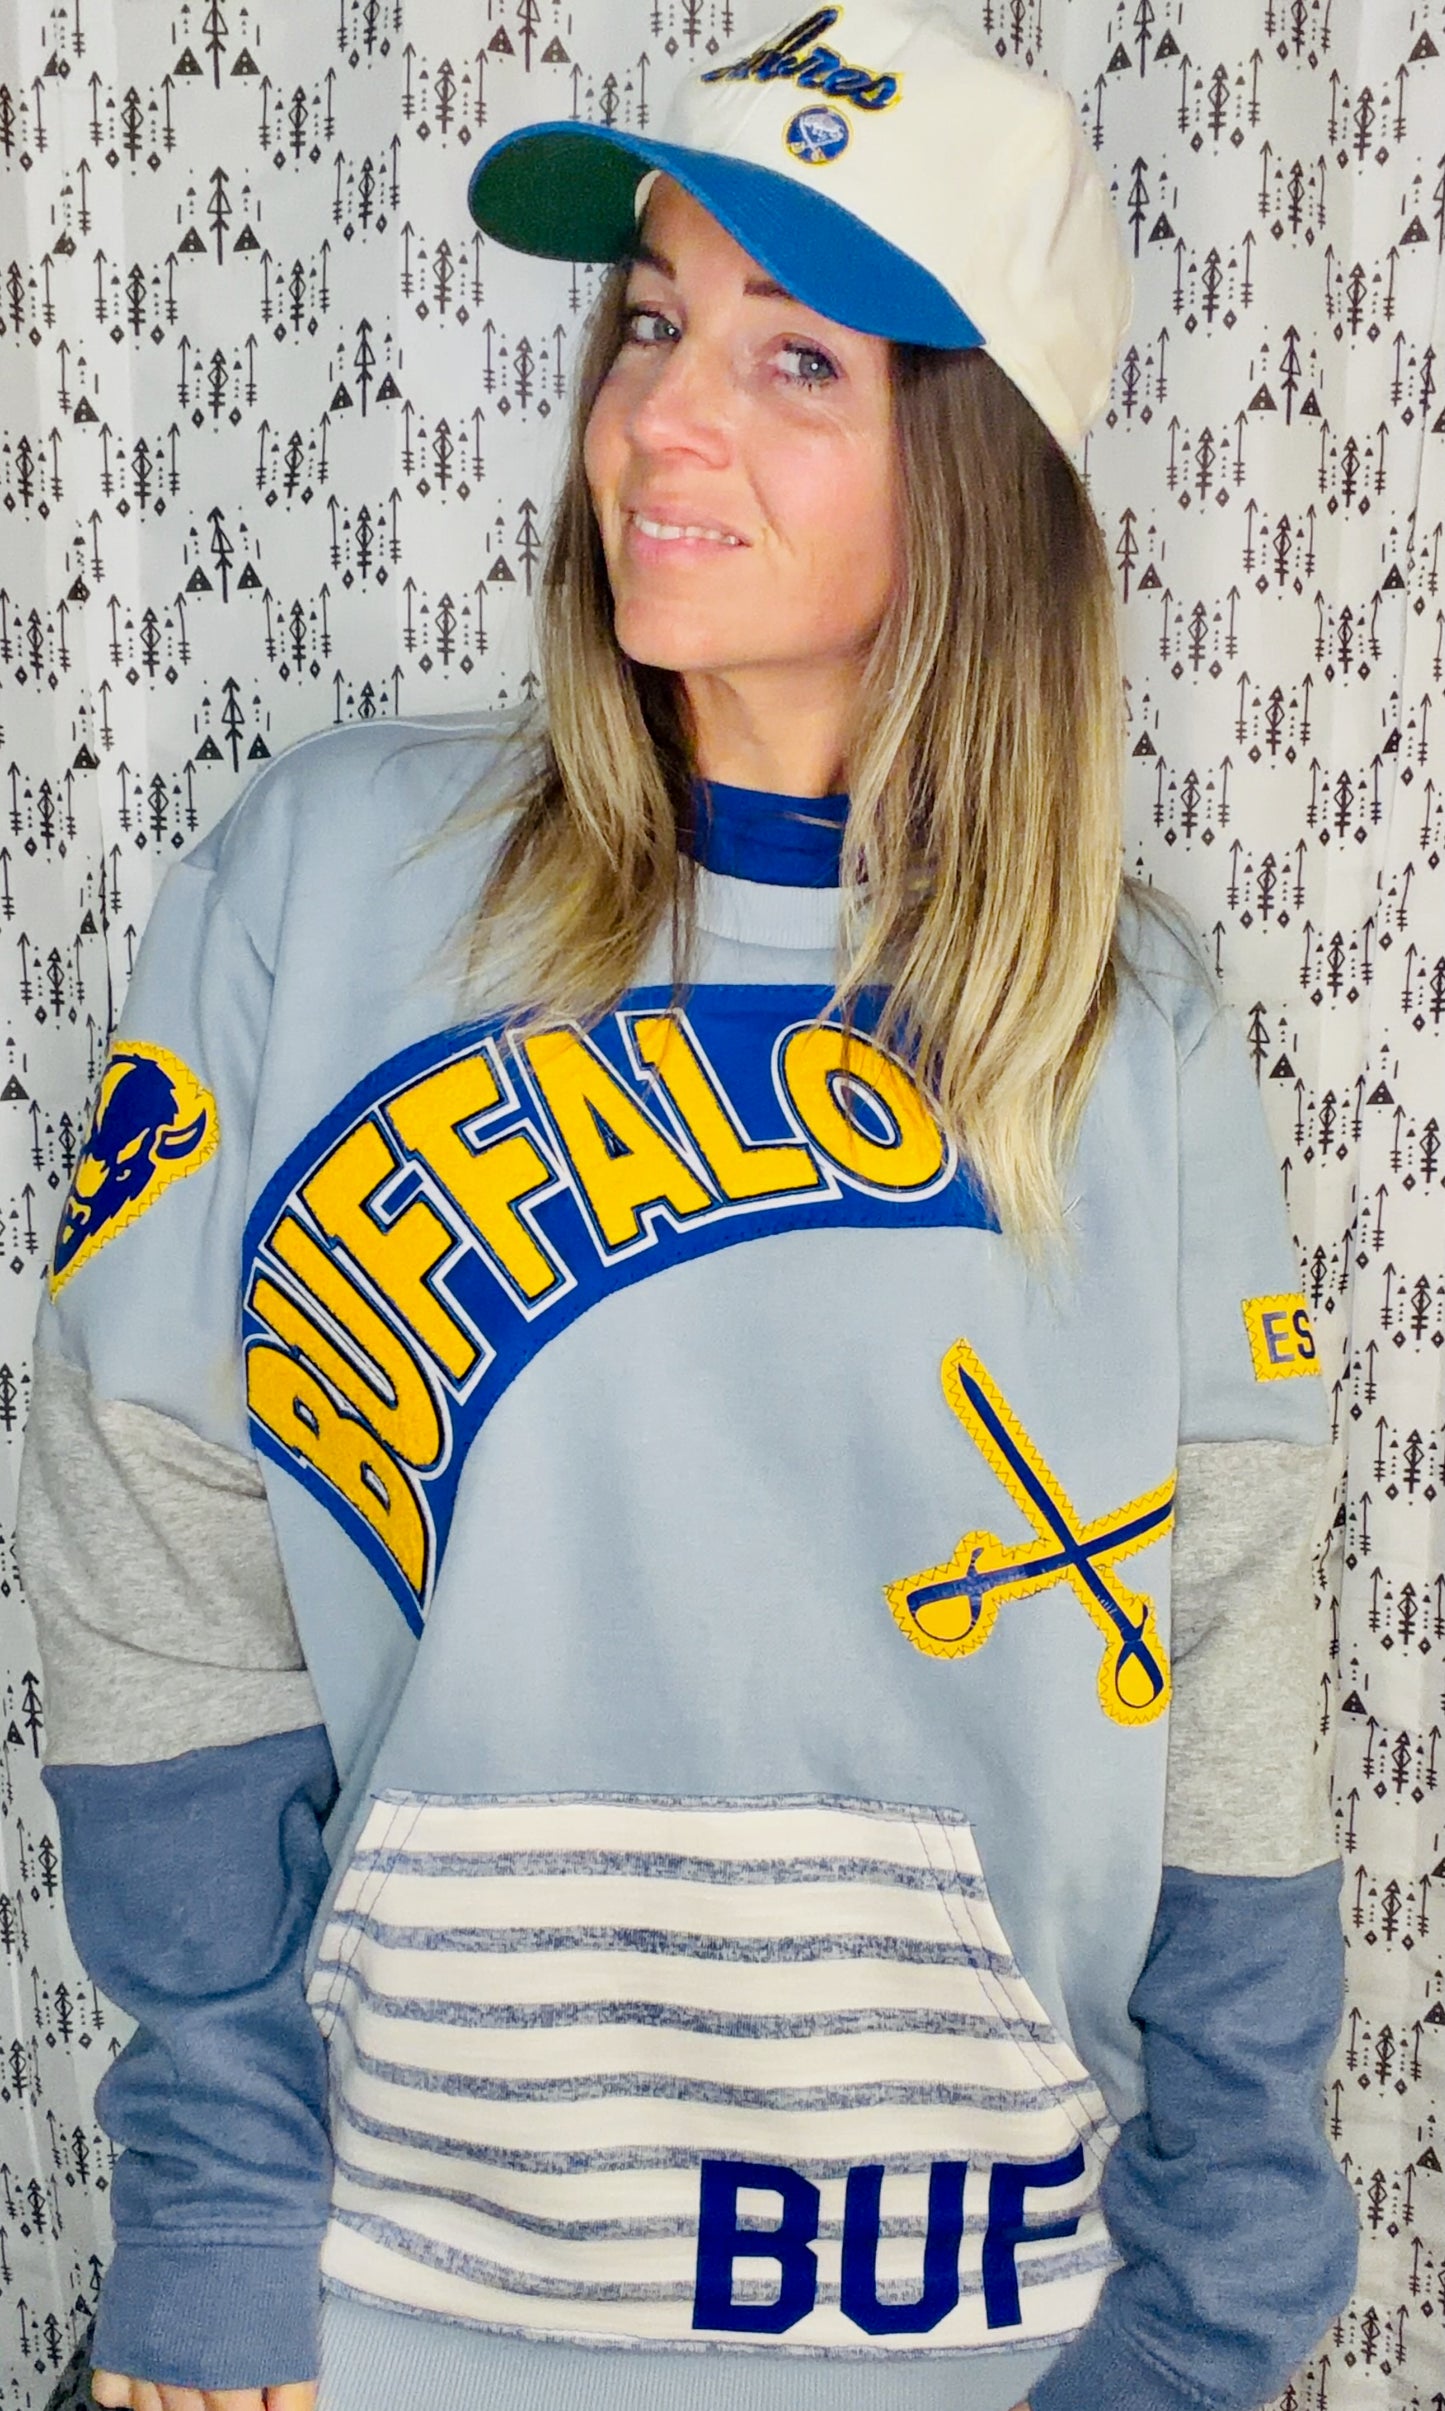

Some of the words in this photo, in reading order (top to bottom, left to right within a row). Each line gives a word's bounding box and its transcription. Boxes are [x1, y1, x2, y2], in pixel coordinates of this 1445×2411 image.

[700, 7, 899, 110] bres
[244, 1009, 957, 1618] BUFFALO
[1262, 1309, 1316, 1364] ES
[692, 2142, 1086, 2336] BUF
